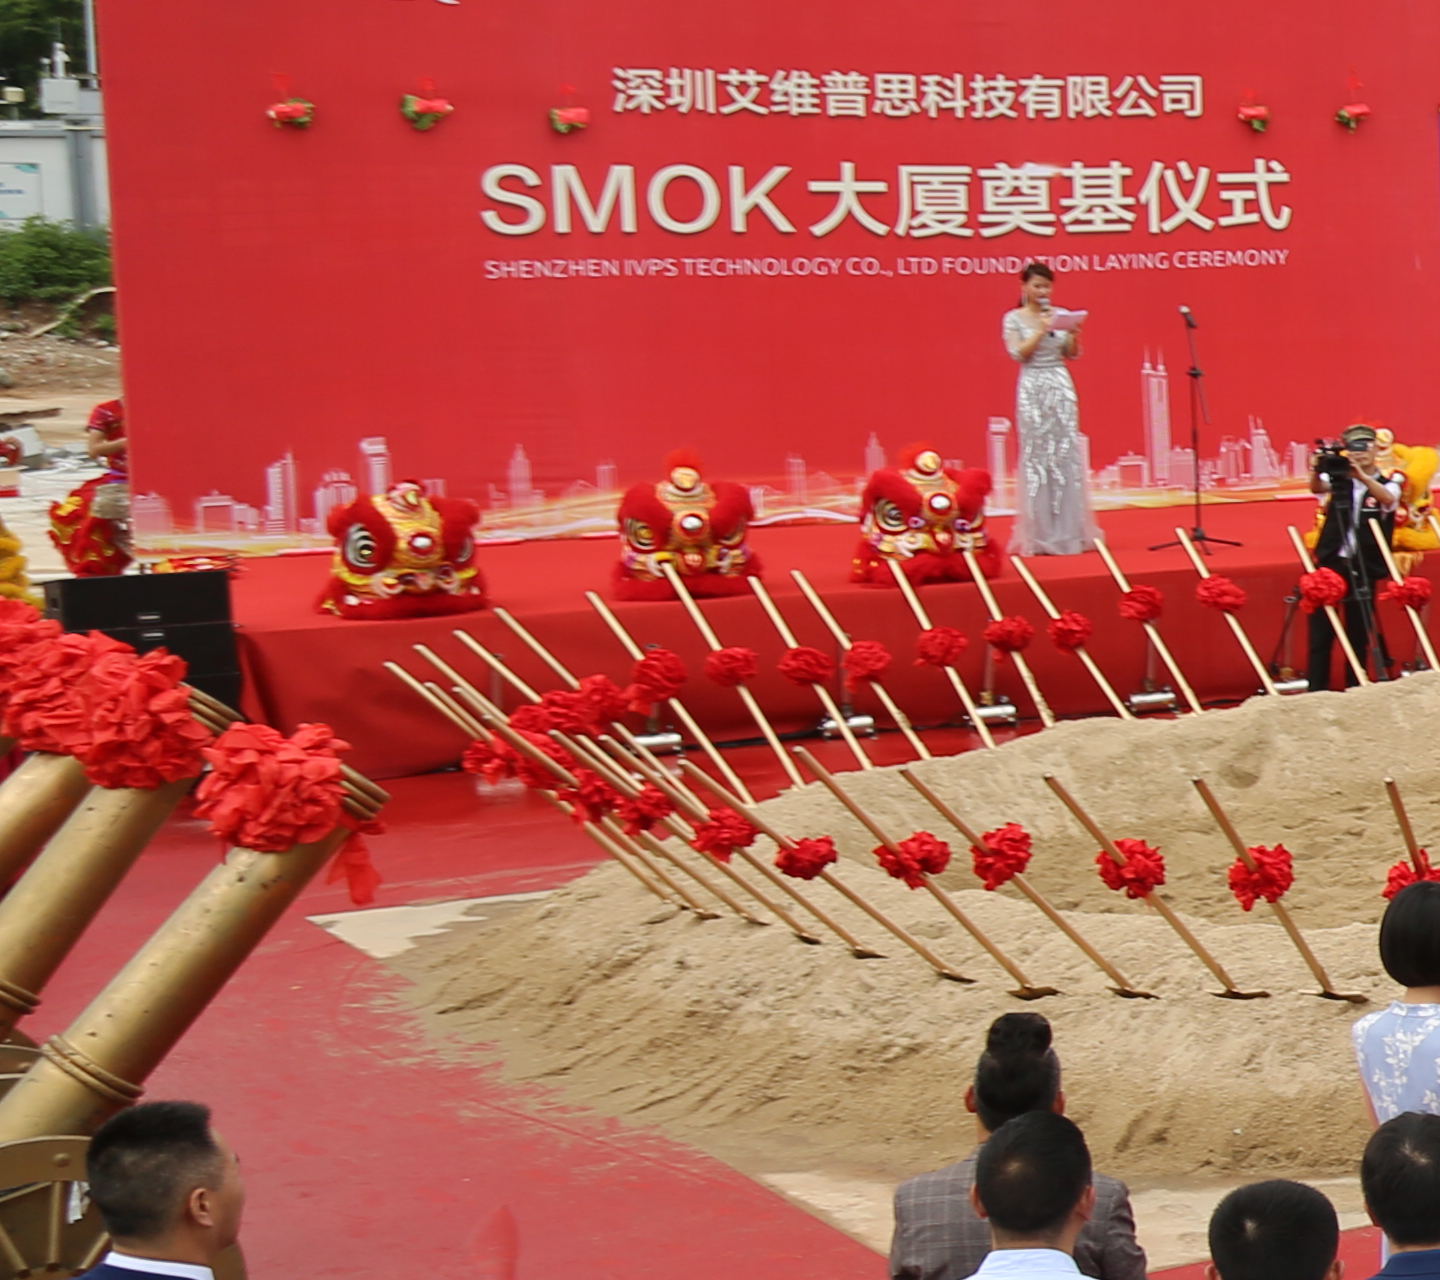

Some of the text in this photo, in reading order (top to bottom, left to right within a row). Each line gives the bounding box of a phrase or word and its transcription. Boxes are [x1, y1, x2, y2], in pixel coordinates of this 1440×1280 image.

[611, 65, 1204, 121] 深圳艾维普思科技有限公司
[484, 259, 620, 279] SHENZHEN
[623, 258, 677, 277] IVPS
[681, 257, 842, 277] TECHNOLOGY
[897, 257, 938, 275] LTD
[1093, 252, 1170, 271] LAYING
[1173, 249, 1290, 269] CEREMONY
